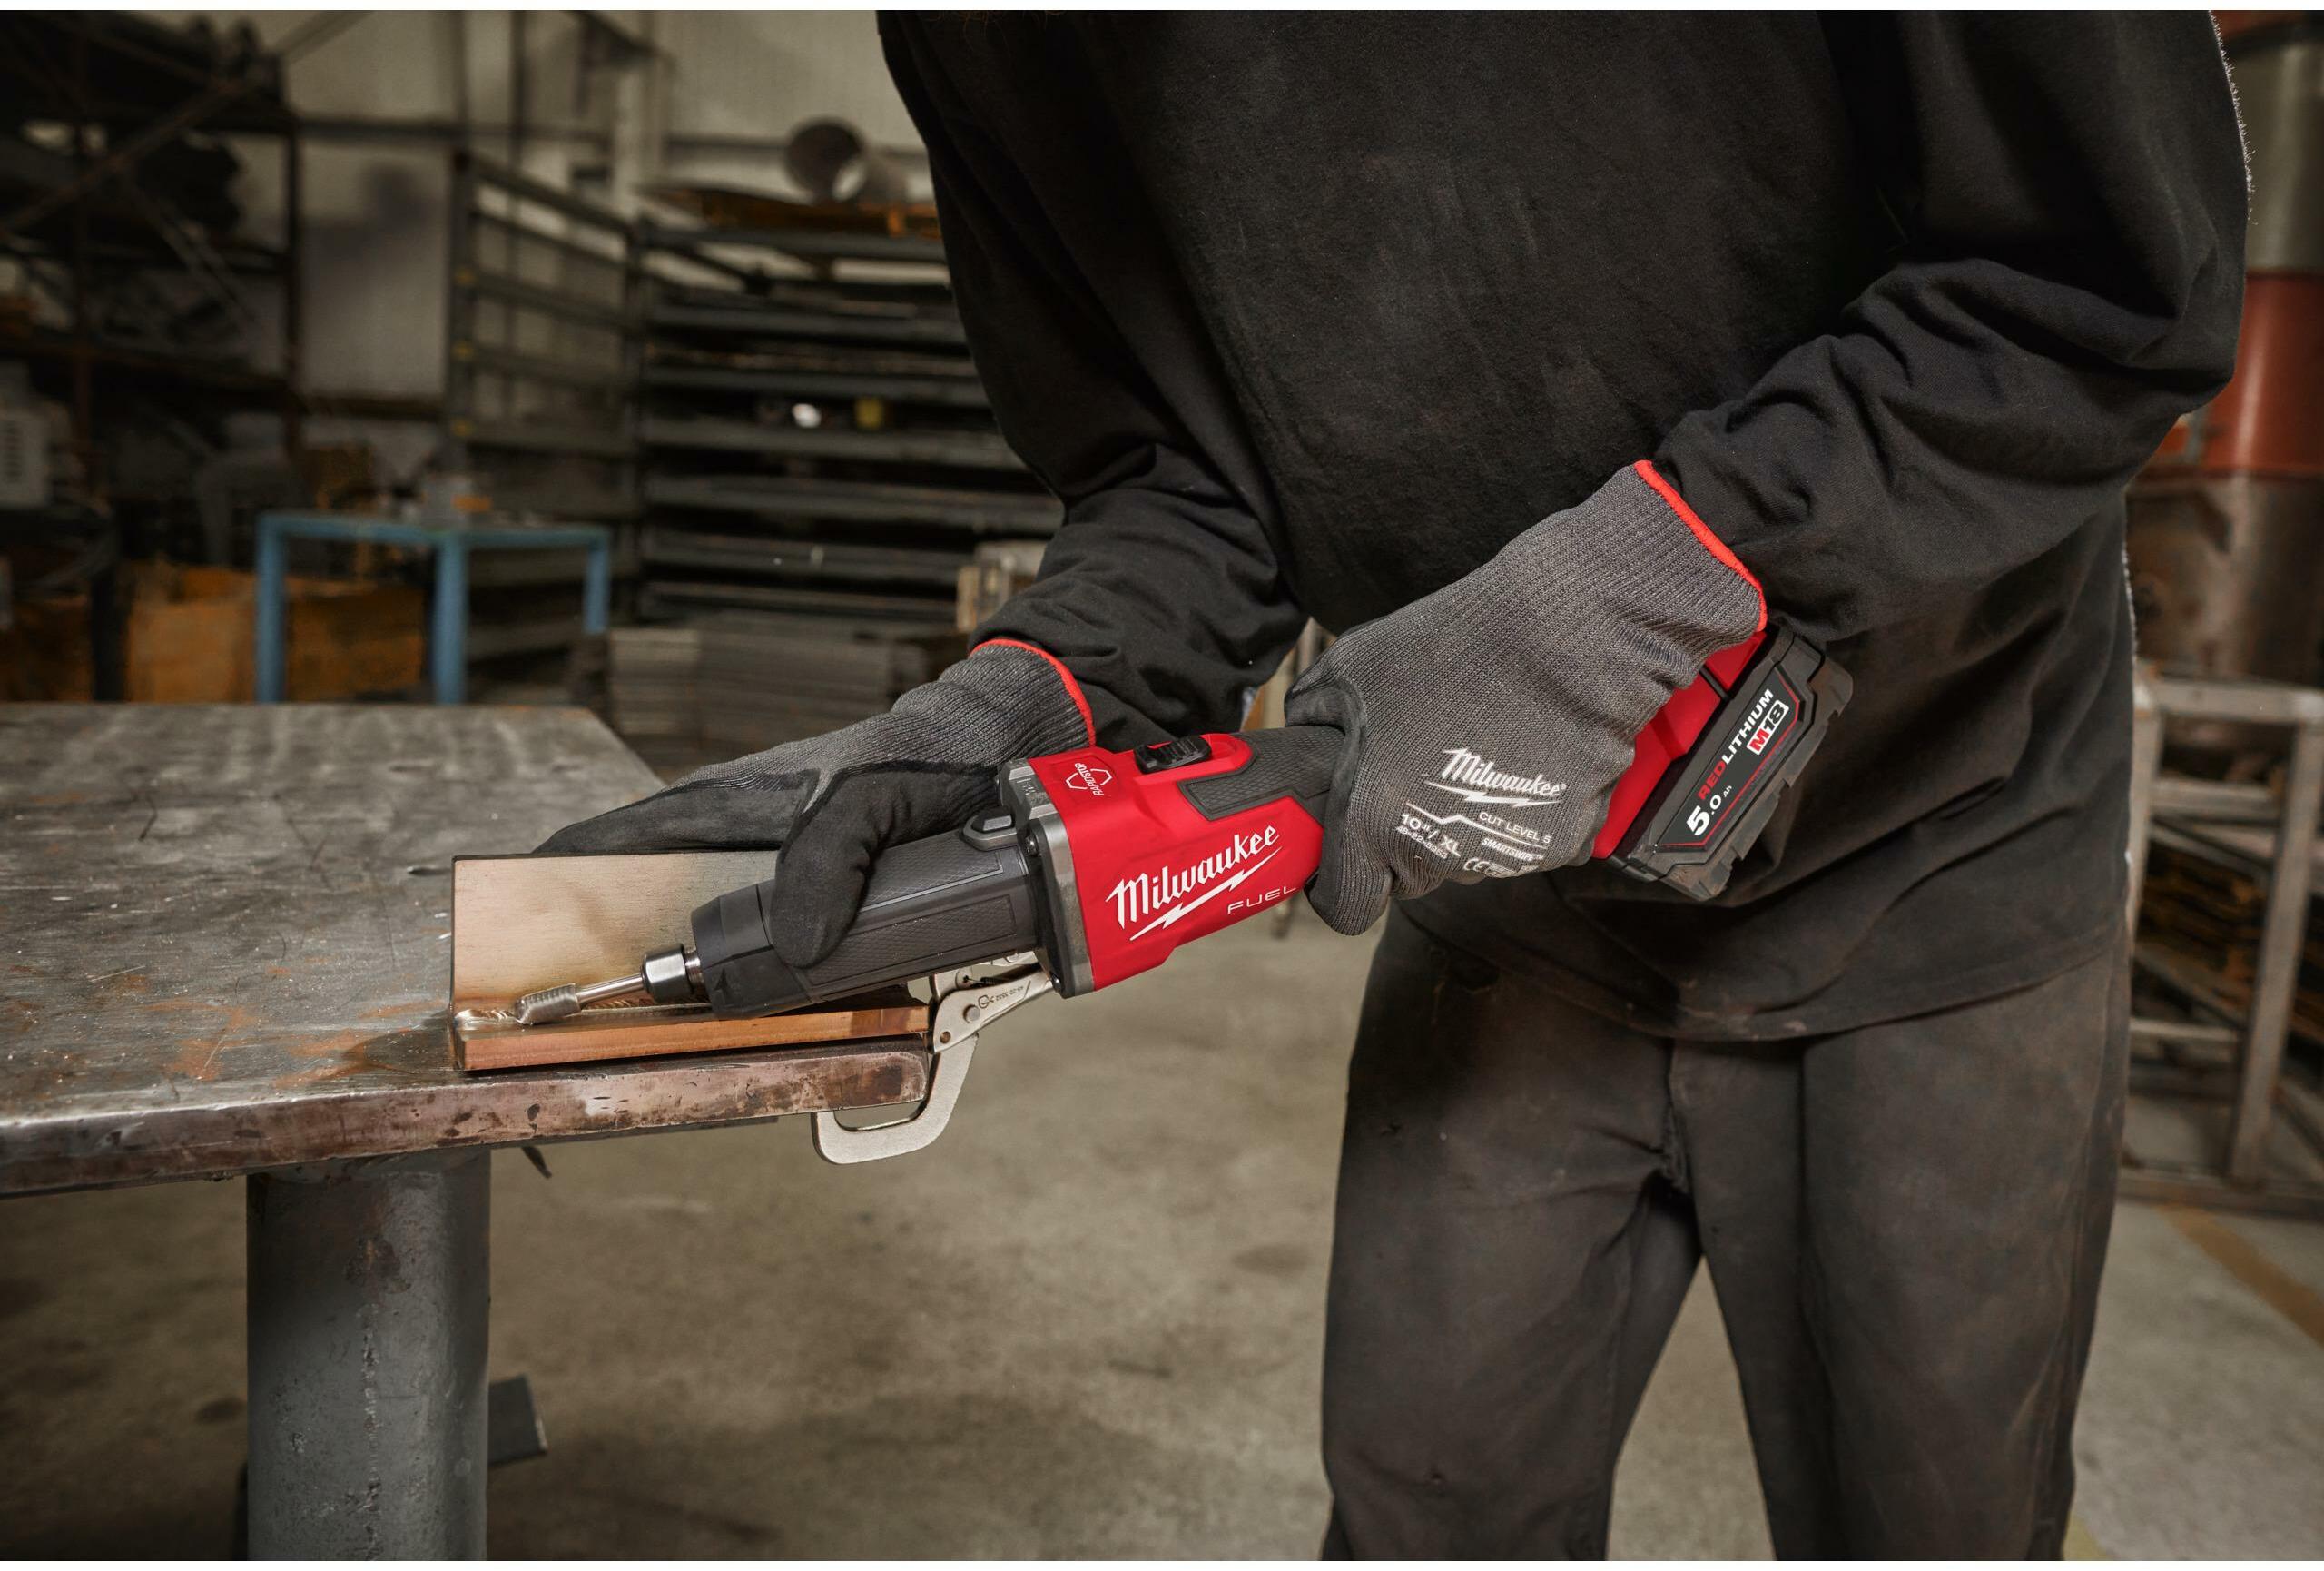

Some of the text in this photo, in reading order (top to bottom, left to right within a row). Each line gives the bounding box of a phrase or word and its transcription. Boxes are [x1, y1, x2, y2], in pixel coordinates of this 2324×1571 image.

[1697, 688, 1774, 801] REDLITHIUM
[1747, 699, 1790, 756] M18
[1479, 812, 1552, 844] CUT LEVEL 5
[1685, 785, 1732, 835] 5.0 Ah
[1440, 835, 1462, 858] XL
[1105, 825, 1280, 930] Milwaukee
[1227, 884, 1297, 915] FUEL
